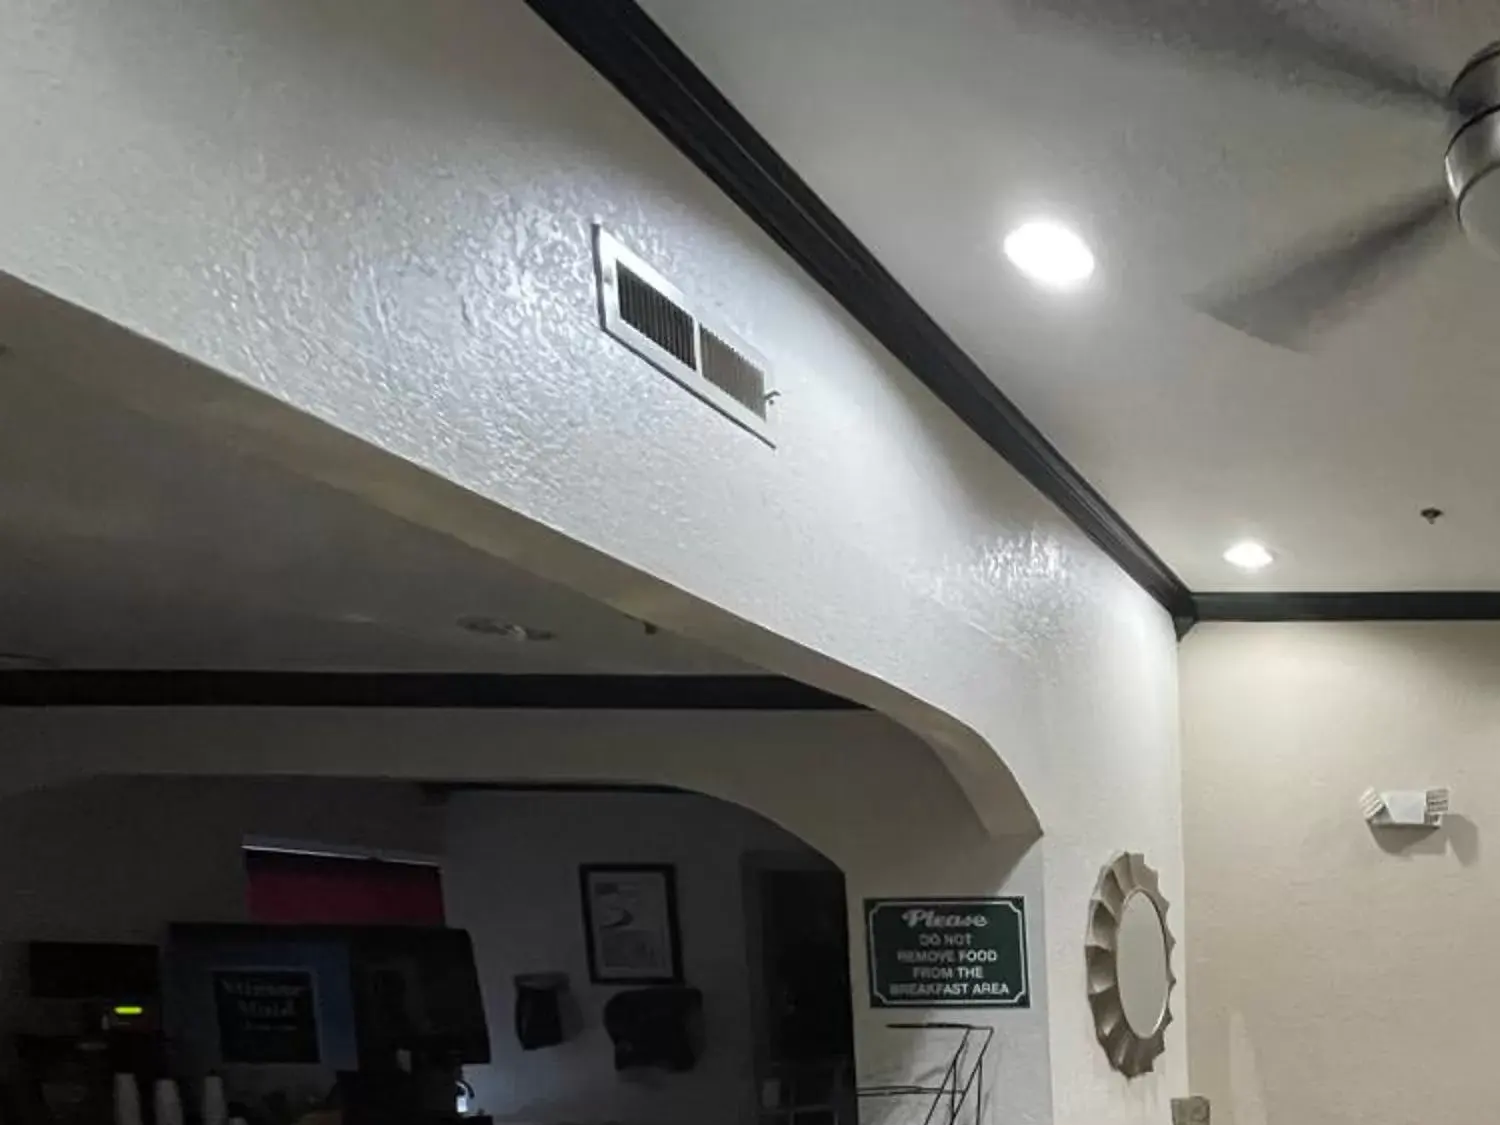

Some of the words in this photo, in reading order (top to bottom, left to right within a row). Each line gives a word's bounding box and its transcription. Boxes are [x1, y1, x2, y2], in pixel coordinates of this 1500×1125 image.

[902, 909, 988, 928] Please
[918, 933, 941, 946] DO
[943, 933, 973, 946] NOT
[897, 949, 956, 963] REMOVE
[959, 949, 998, 962] FOOD
[912, 966, 953, 979] FROM
[957, 966, 984, 979] THE
[889, 983, 969, 996] BREAKFAST
[972, 983, 1009, 995] AREA
